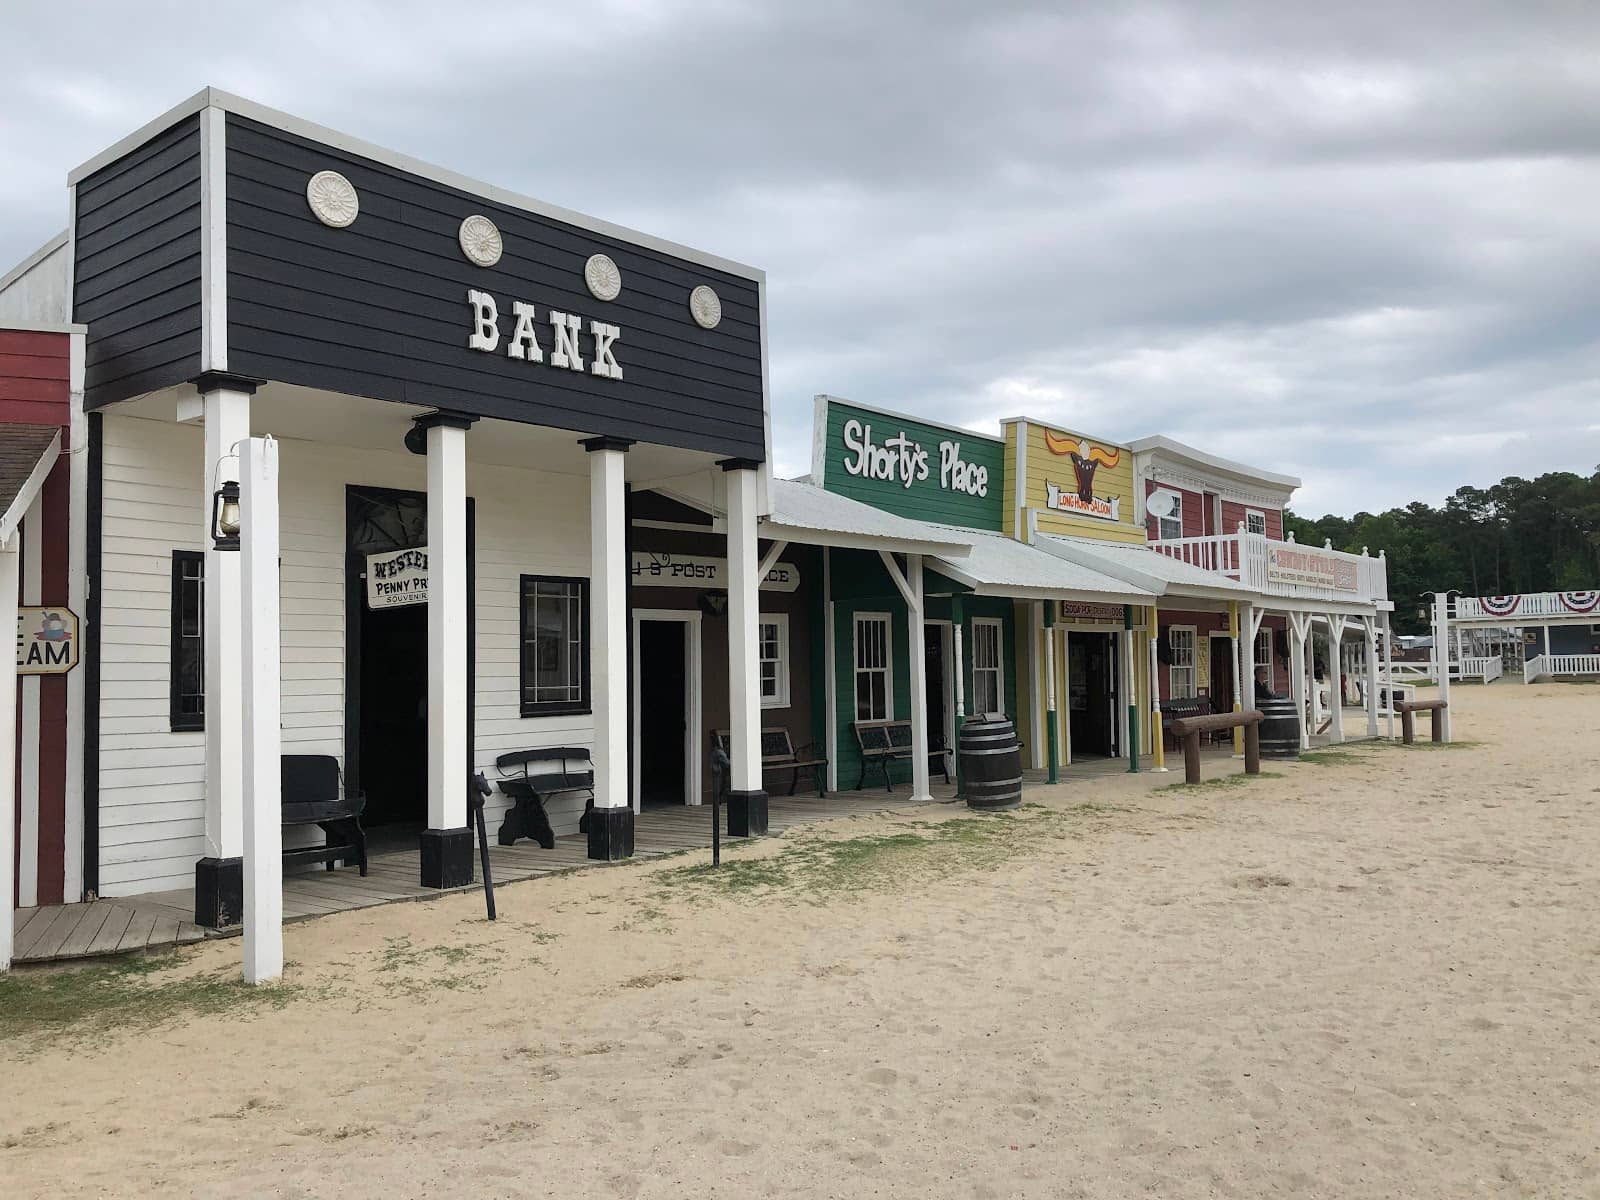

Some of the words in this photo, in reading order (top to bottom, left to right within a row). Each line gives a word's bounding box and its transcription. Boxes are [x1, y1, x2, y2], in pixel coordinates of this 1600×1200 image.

[468, 289, 623, 380] BANK
[844, 420, 929, 489] Shorty's
[940, 441, 988, 498] Place
[1090, 500, 1111, 514] SALOON
[671, 563, 716, 579] POST
[763, 569, 789, 583] CE
[376, 580, 409, 595] PENNY
[413, 577, 428, 591] PR
[386, 593, 427, 603] SOUVENIR
